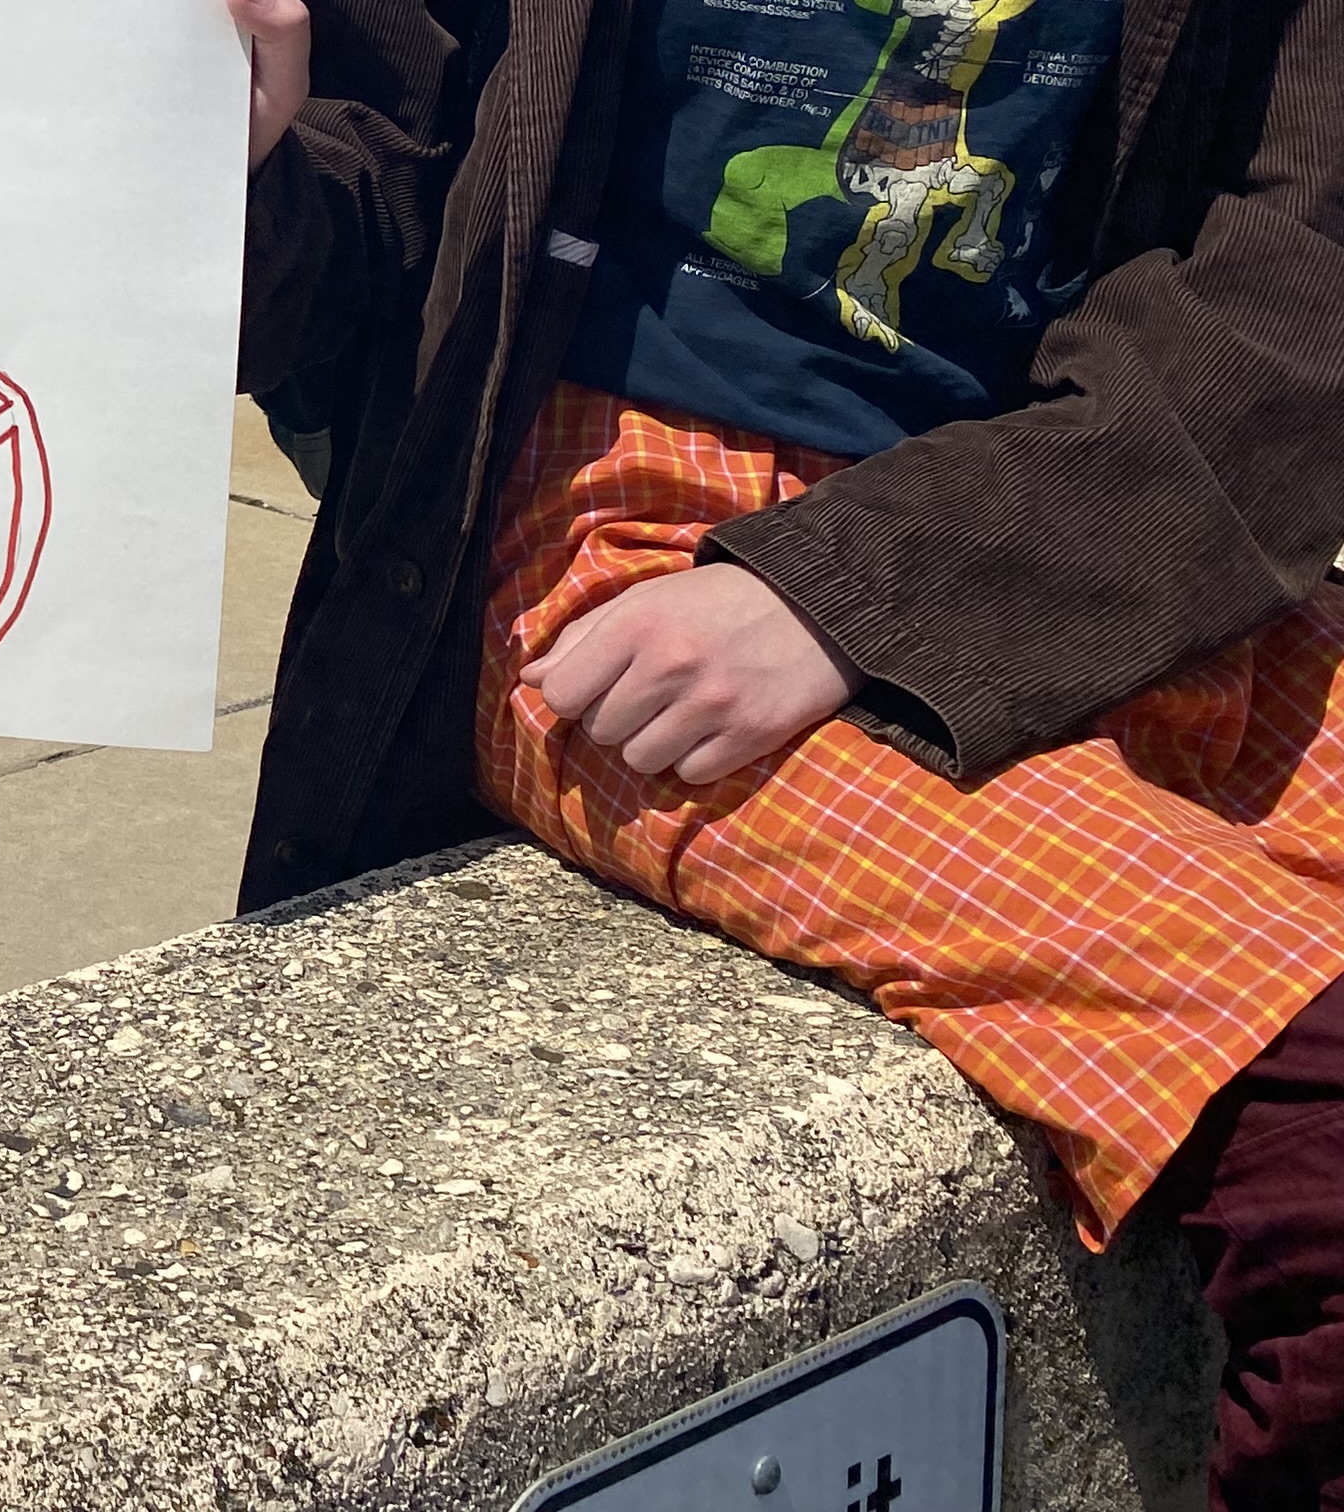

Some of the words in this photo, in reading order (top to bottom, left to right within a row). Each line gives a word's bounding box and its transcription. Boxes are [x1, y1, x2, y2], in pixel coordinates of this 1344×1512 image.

[689, 55, 732, 68] DEVICE
[733, 62, 798, 86] COMPOSED
[800, 77, 818, 88] OF
[690, 44, 747, 63] INTERNAL
[749, 56, 829, 79] COMBUSTION
[708, 67, 740, 85] PARTS
[916, 117, 953, 144] TNT
